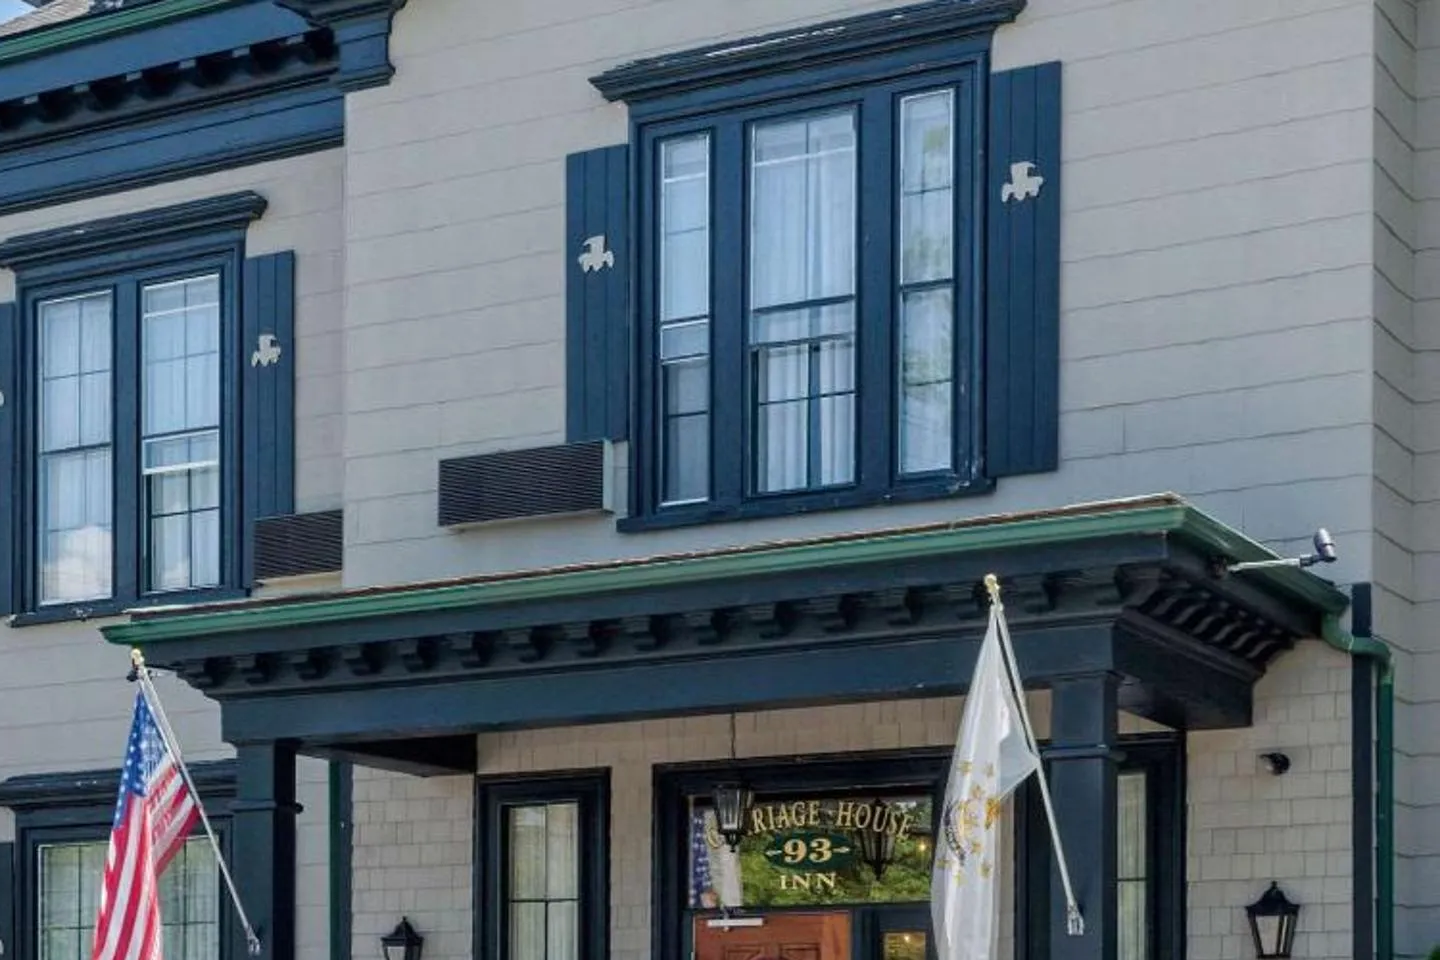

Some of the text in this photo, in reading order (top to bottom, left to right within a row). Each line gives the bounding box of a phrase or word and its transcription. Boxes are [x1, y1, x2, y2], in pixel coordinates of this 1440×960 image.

[835, 801, 915, 840] HOUSE
[784, 838, 832, 863] 93
[780, 872, 836, 893] INN
